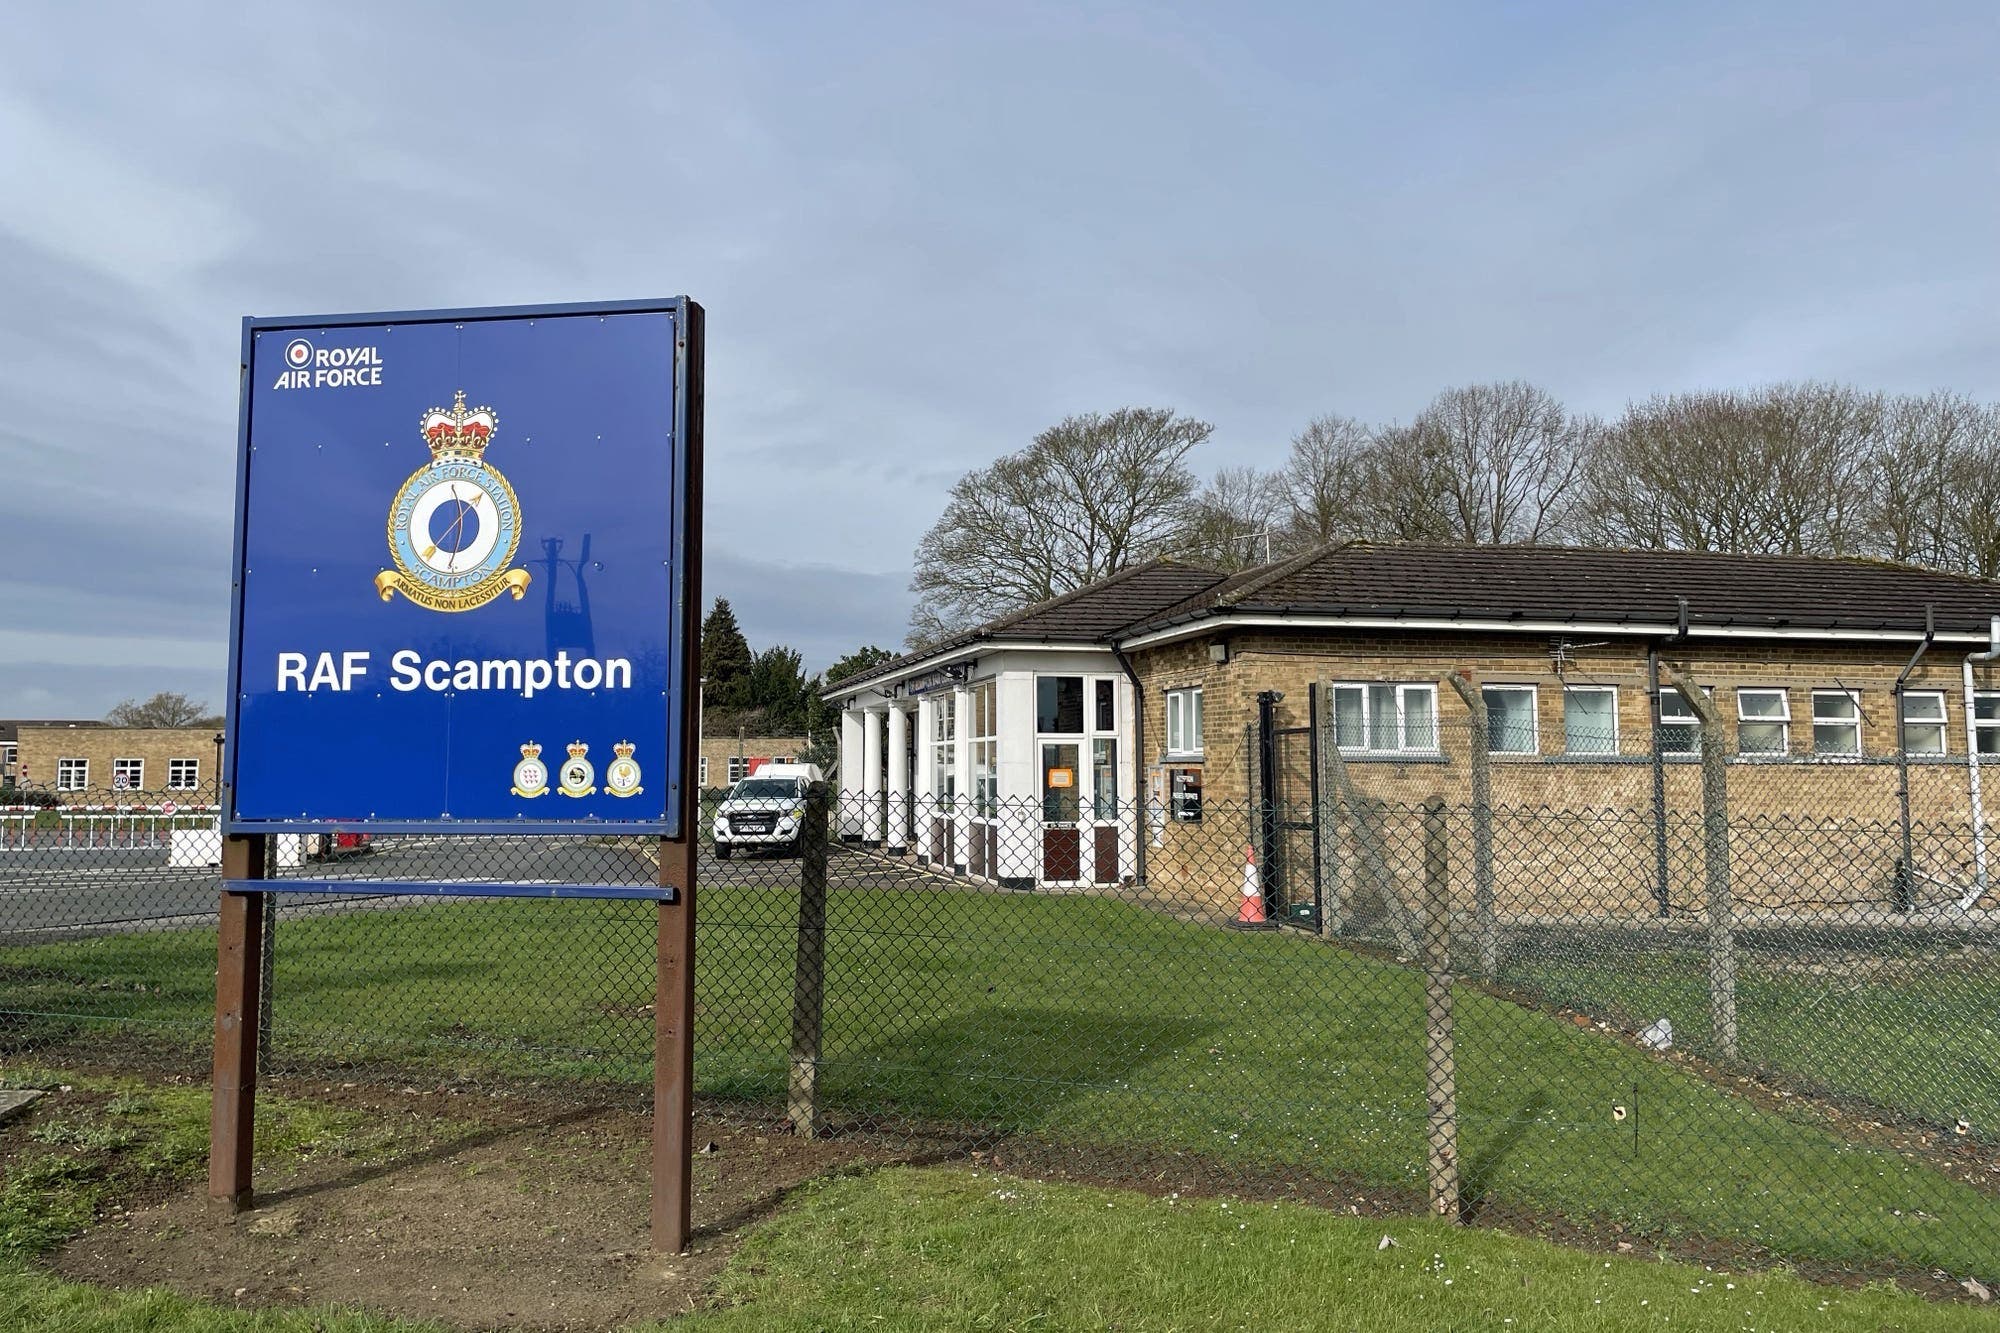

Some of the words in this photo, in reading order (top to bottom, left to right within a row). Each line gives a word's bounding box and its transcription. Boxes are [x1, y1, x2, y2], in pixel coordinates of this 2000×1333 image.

[316, 347, 383, 367] ROYAL
[273, 370, 311, 390] AIR
[315, 367, 383, 388] FORCE
[396, 491, 420, 531] ROYAL
[420, 472, 441, 492] AIR
[441, 466, 485, 483] FORCE
[485, 478, 513, 531] STATION
[413, 563, 494, 588] SCAMPTON
[393, 576, 433, 606] ARMATUS
[434, 600, 457, 610] NON
[458, 576, 511, 609] LACESSITUR
[277, 651, 370, 692] RAF
[390, 650, 632, 698] Scampton
[115, 776, 128, 784] 20
